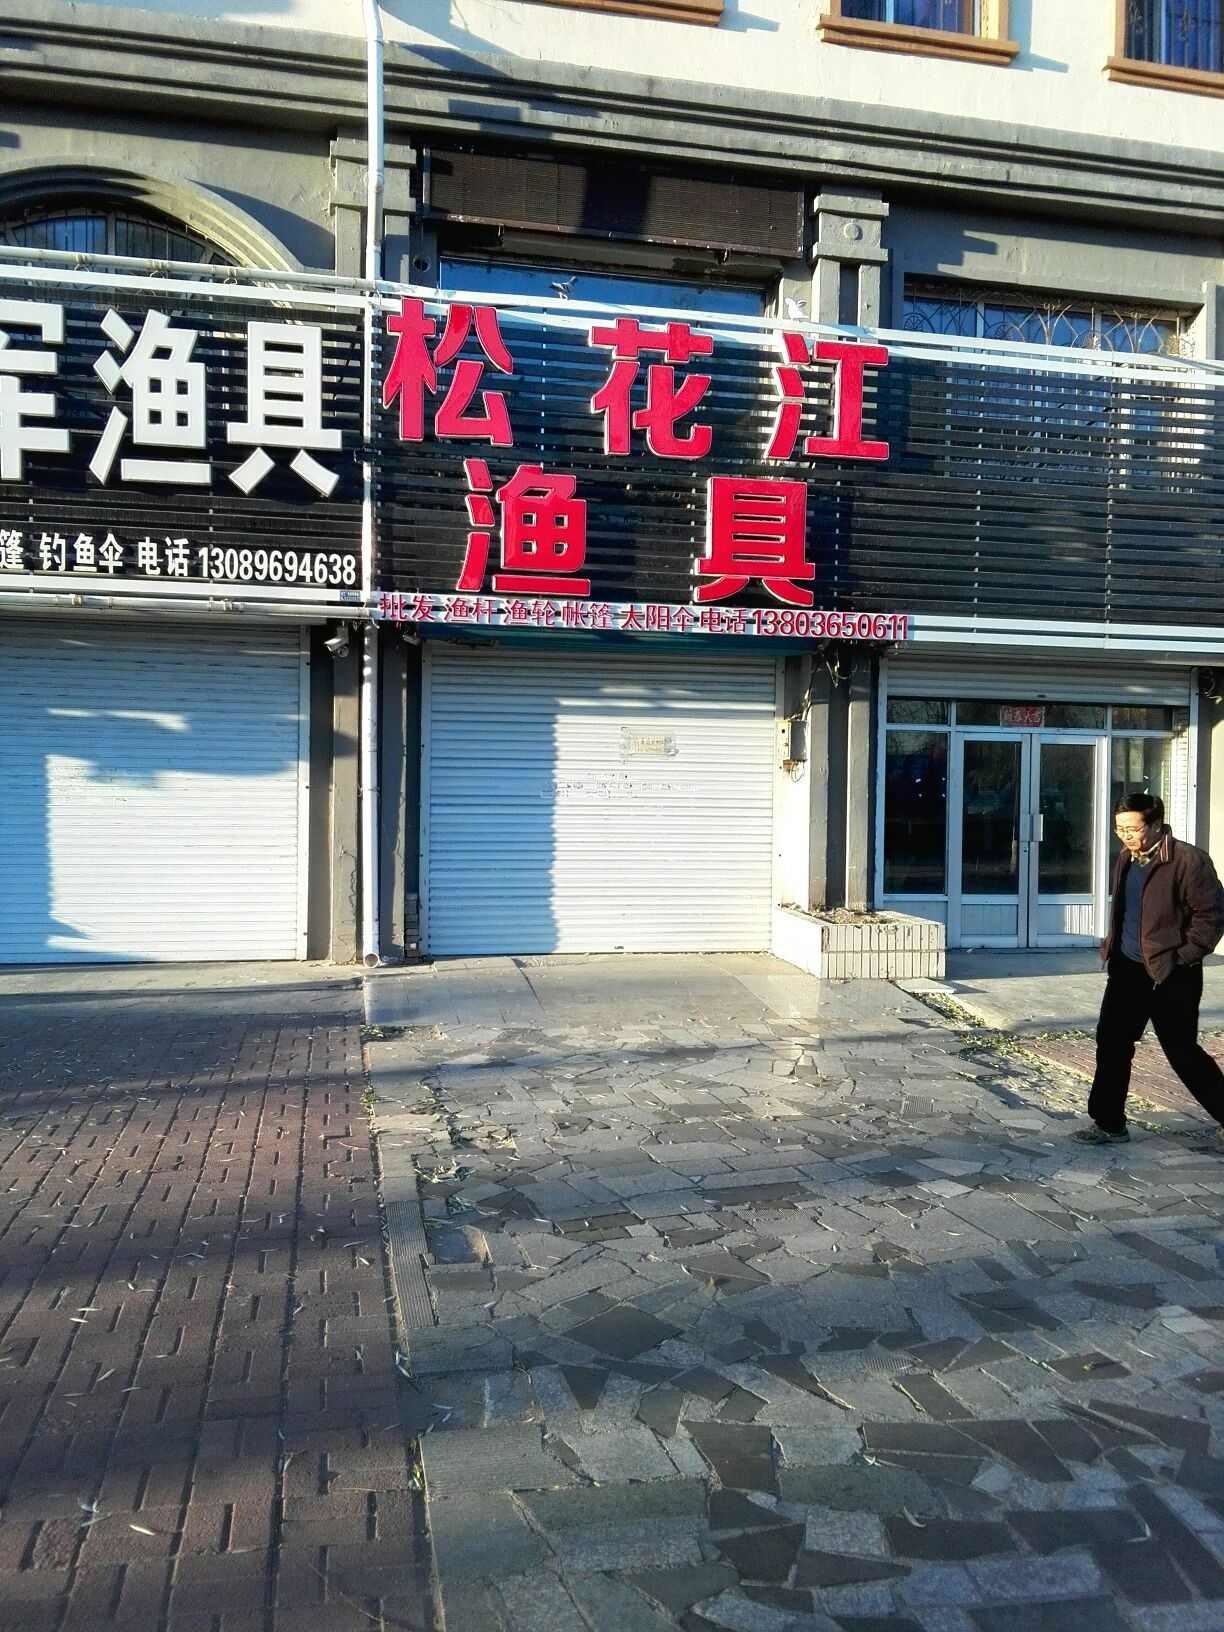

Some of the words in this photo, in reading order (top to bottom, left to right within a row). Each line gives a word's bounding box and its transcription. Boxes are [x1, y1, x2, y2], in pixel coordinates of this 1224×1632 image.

[383, 297, 890, 461] 松花江
[39, 532, 124, 574] 钓鱼伞
[137, 536, 190, 577] 电话
[198, 547, 357, 585] 13089694638
[456, 457, 817, 608] 渔具
[380, 593, 435, 620] 批发
[444, 598, 498, 624] 渔杆
[504, 599, 556, 626] 渔轮
[620, 605, 694, 632] 太阳伞
[699, 608, 747, 634] 电话
[753, 609, 909, 640] 13803650611
